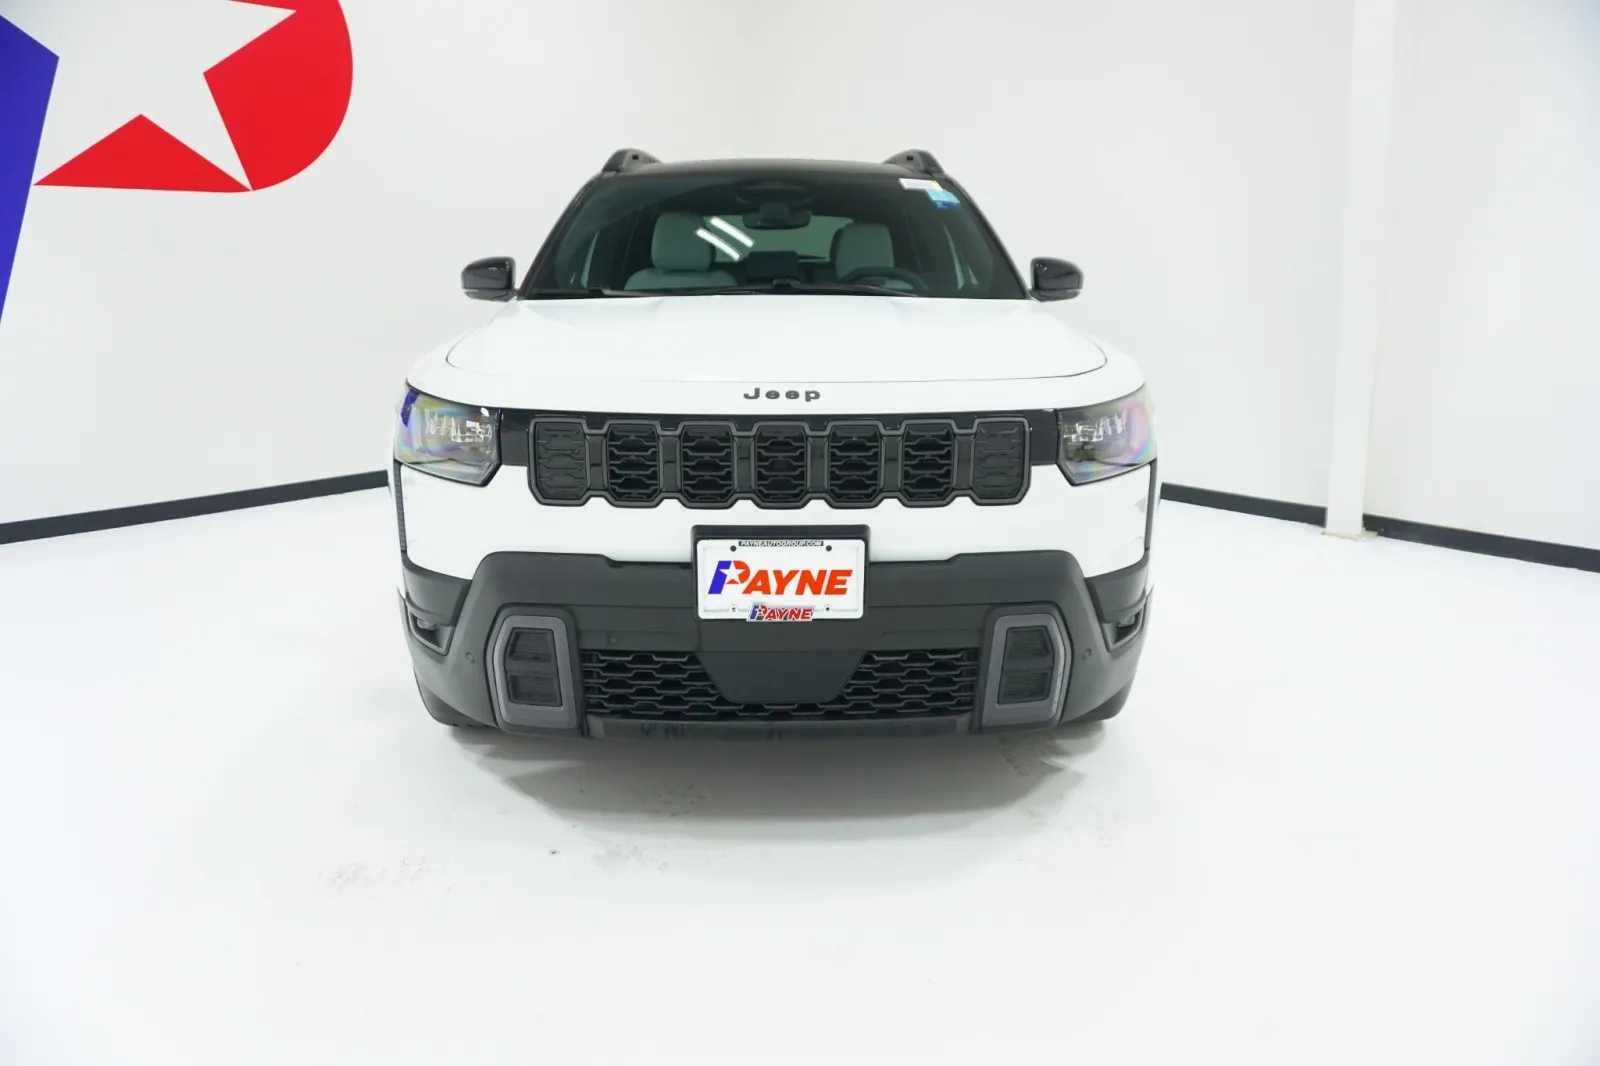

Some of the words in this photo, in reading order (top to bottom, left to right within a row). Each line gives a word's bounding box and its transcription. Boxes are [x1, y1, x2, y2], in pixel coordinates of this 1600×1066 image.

[743, 387, 821, 402] Jeep
[708, 560, 853, 595] PAYNE
[750, 605, 814, 620] PAYNE
